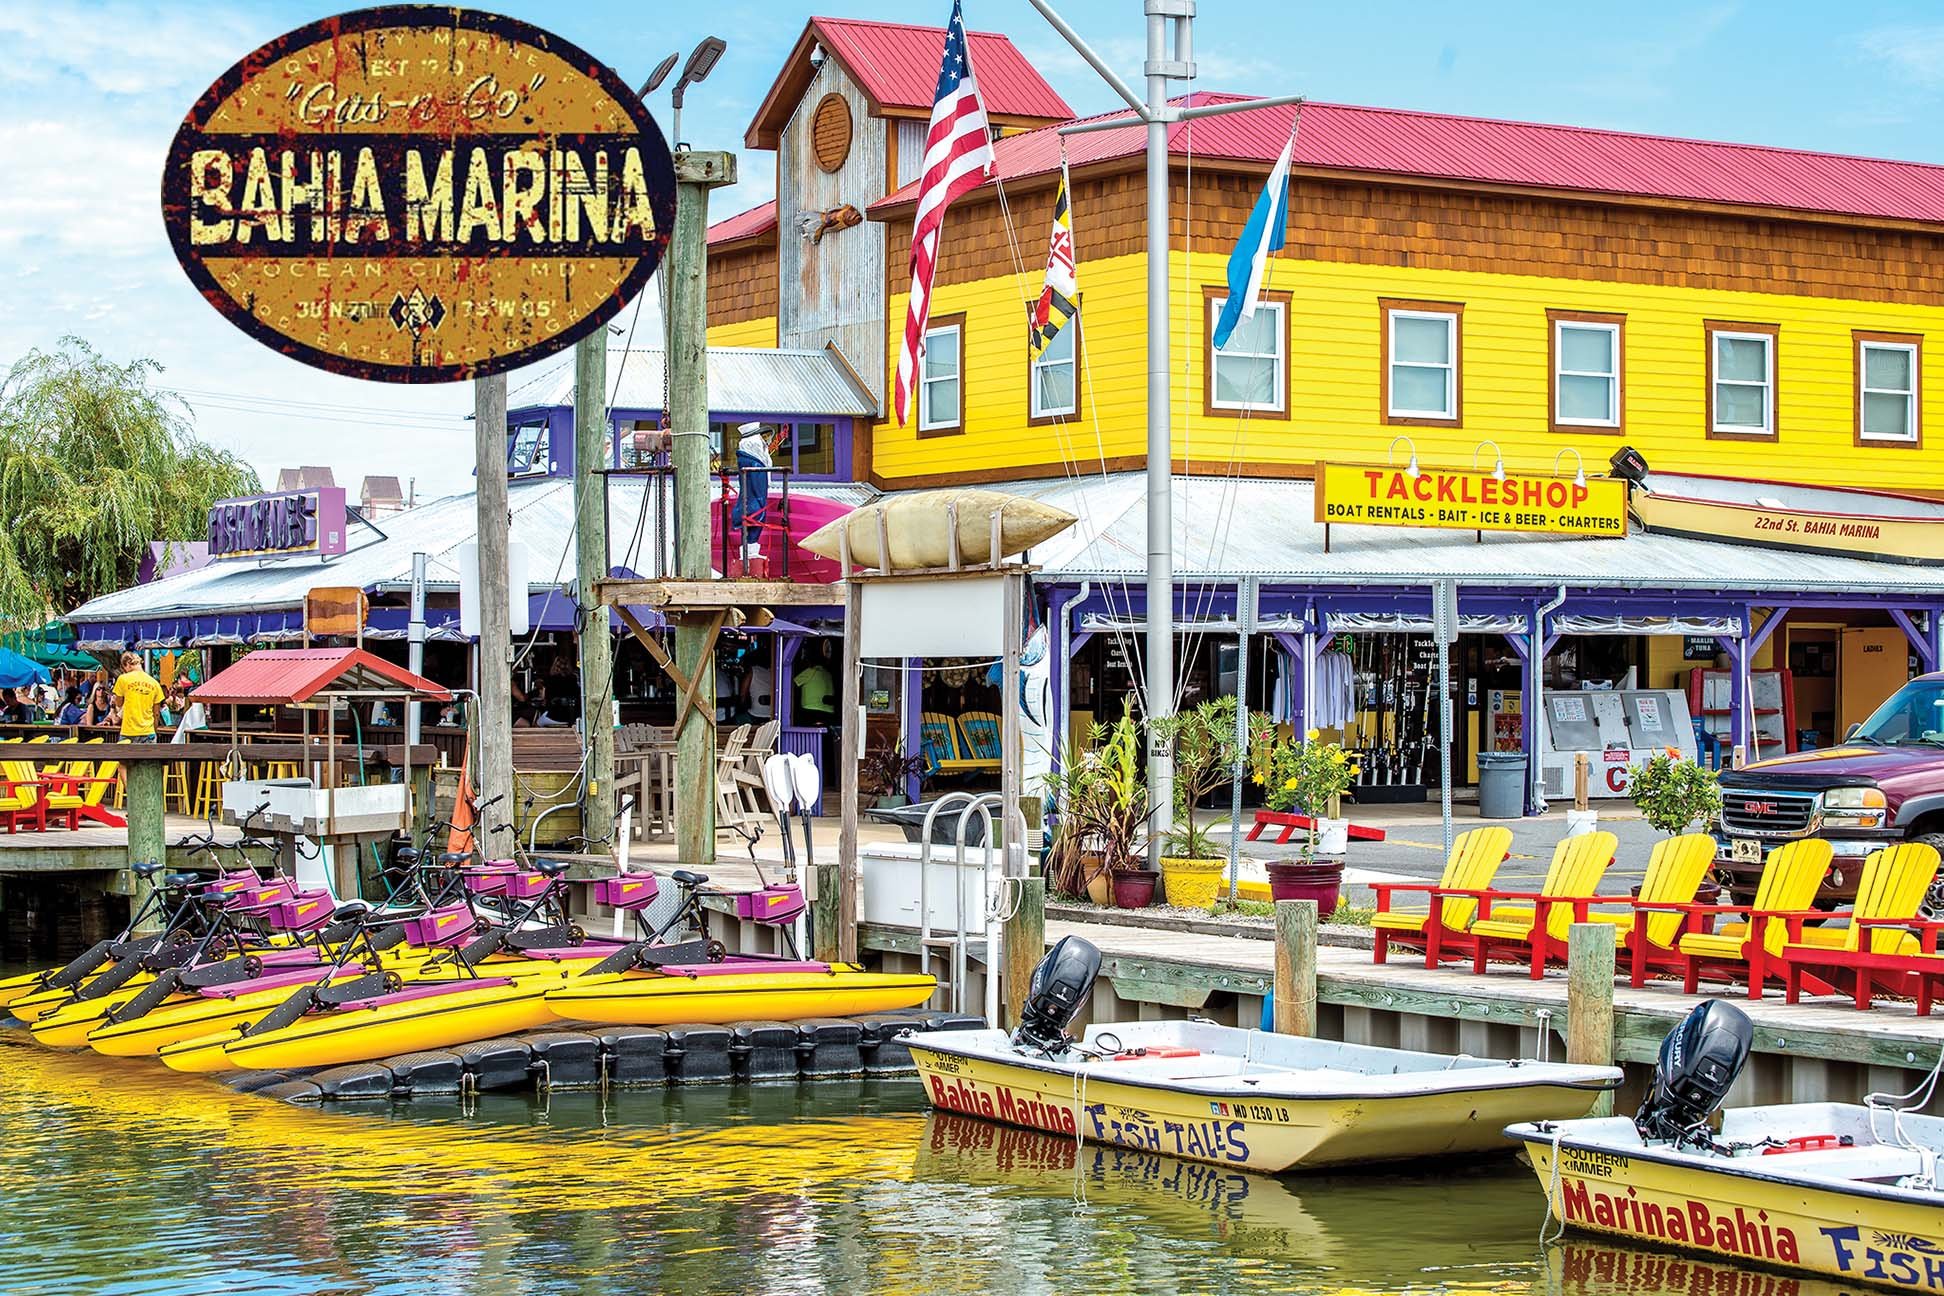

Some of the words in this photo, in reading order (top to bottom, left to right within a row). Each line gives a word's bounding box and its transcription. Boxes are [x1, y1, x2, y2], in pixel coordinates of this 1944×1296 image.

[1364, 471, 1588, 509] TACKLESHOP
[1327, 503, 1363, 517] BOAT
[1367, 506, 1425, 520] RENTALS
[1438, 508, 1467, 522] BAIT
[1480, 511, 1500, 524] ICE
[1504, 513, 1511, 525] &
[1515, 513, 1547, 527] BEER
[1559, 515, 1620, 530] CHARTERS
[1754, 516, 1782, 531] 22nd
[1785, 519, 1799, 533] St.
[1803, 521, 1837, 537] BAHIA
[1839, 523, 1880, 539] MARINA
[1744, 801, 1778, 815] GMC
[929, 1074, 996, 1119] Bahia
[995, 1086, 1077, 1136] Marina
[1233, 1103, 1248, 1118] MD
[1250, 1105, 1273, 1122] 1250
[1276, 1107, 1290, 1122] LB
[1084, 1103, 1161, 1151] FISH
[1164, 1119, 1250, 1162] TALES
